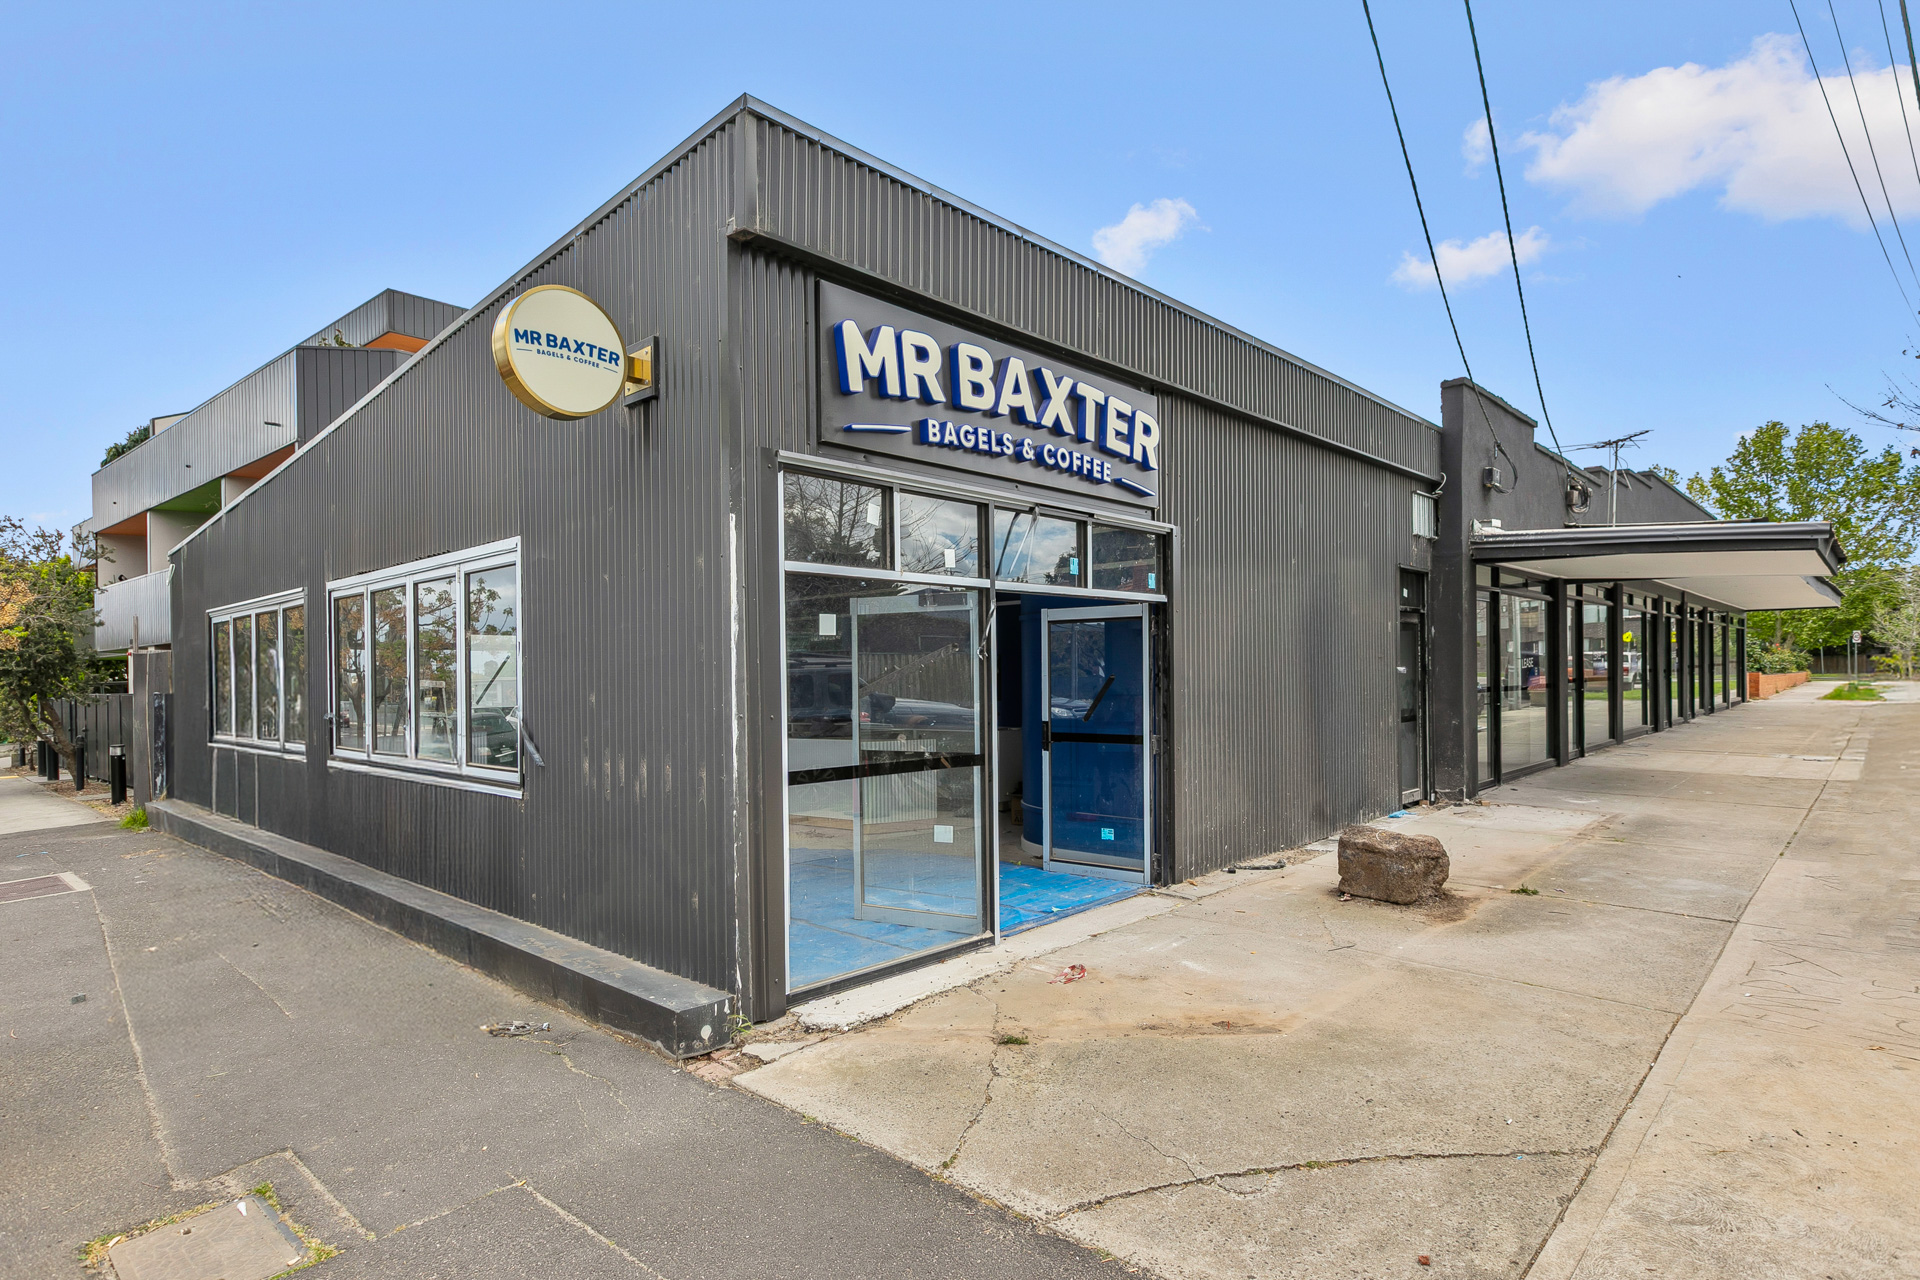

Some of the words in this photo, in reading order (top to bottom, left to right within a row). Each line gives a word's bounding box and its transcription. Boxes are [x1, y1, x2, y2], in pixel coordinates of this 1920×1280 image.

[514, 328, 542, 345] MR
[546, 333, 620, 366] BAXTER
[536, 348, 564, 359] BAGELS
[573, 356, 600, 368] COFFEE
[834, 318, 946, 404] MR
[950, 341, 1160, 470] BAXTER
[921, 417, 1015, 457] BAGELS
[1016, 437, 1035, 462] &
[1037, 443, 1112, 484] COFFEE
